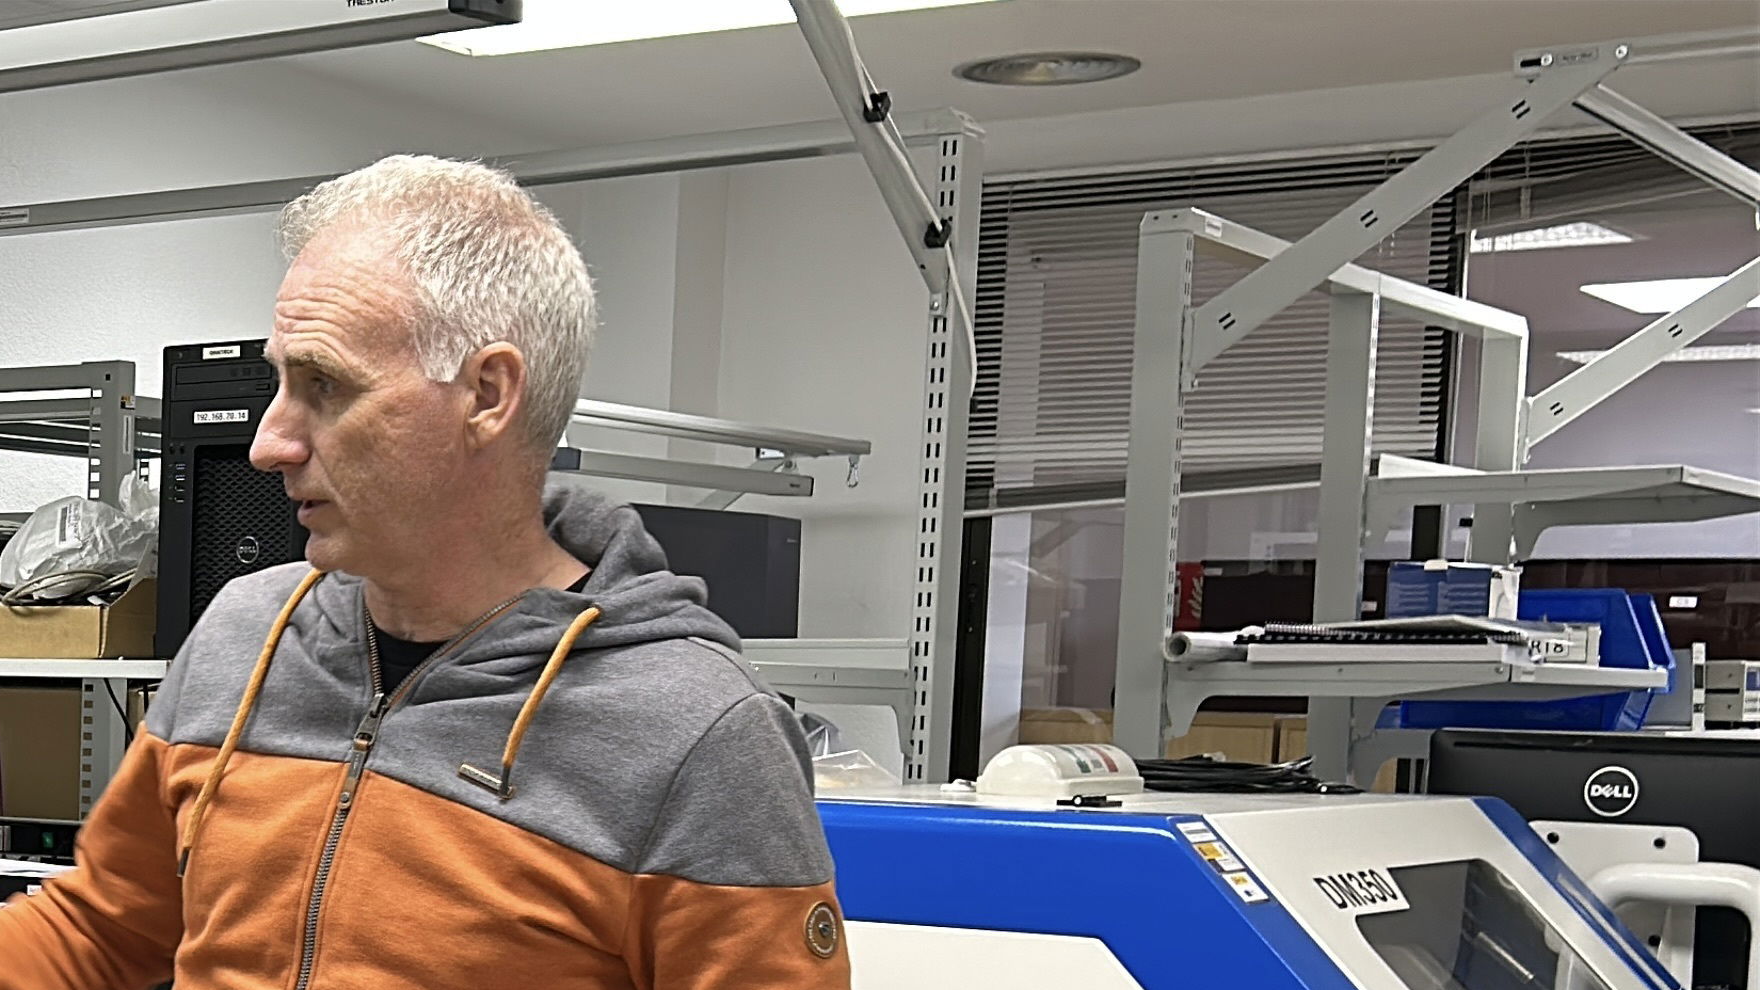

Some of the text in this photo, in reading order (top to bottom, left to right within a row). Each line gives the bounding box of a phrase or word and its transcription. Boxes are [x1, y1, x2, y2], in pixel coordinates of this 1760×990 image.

[346, 0, 395, 8] TRES
[1589, 784, 1632, 799] DELL
[1313, 869, 1398, 909] DM350
